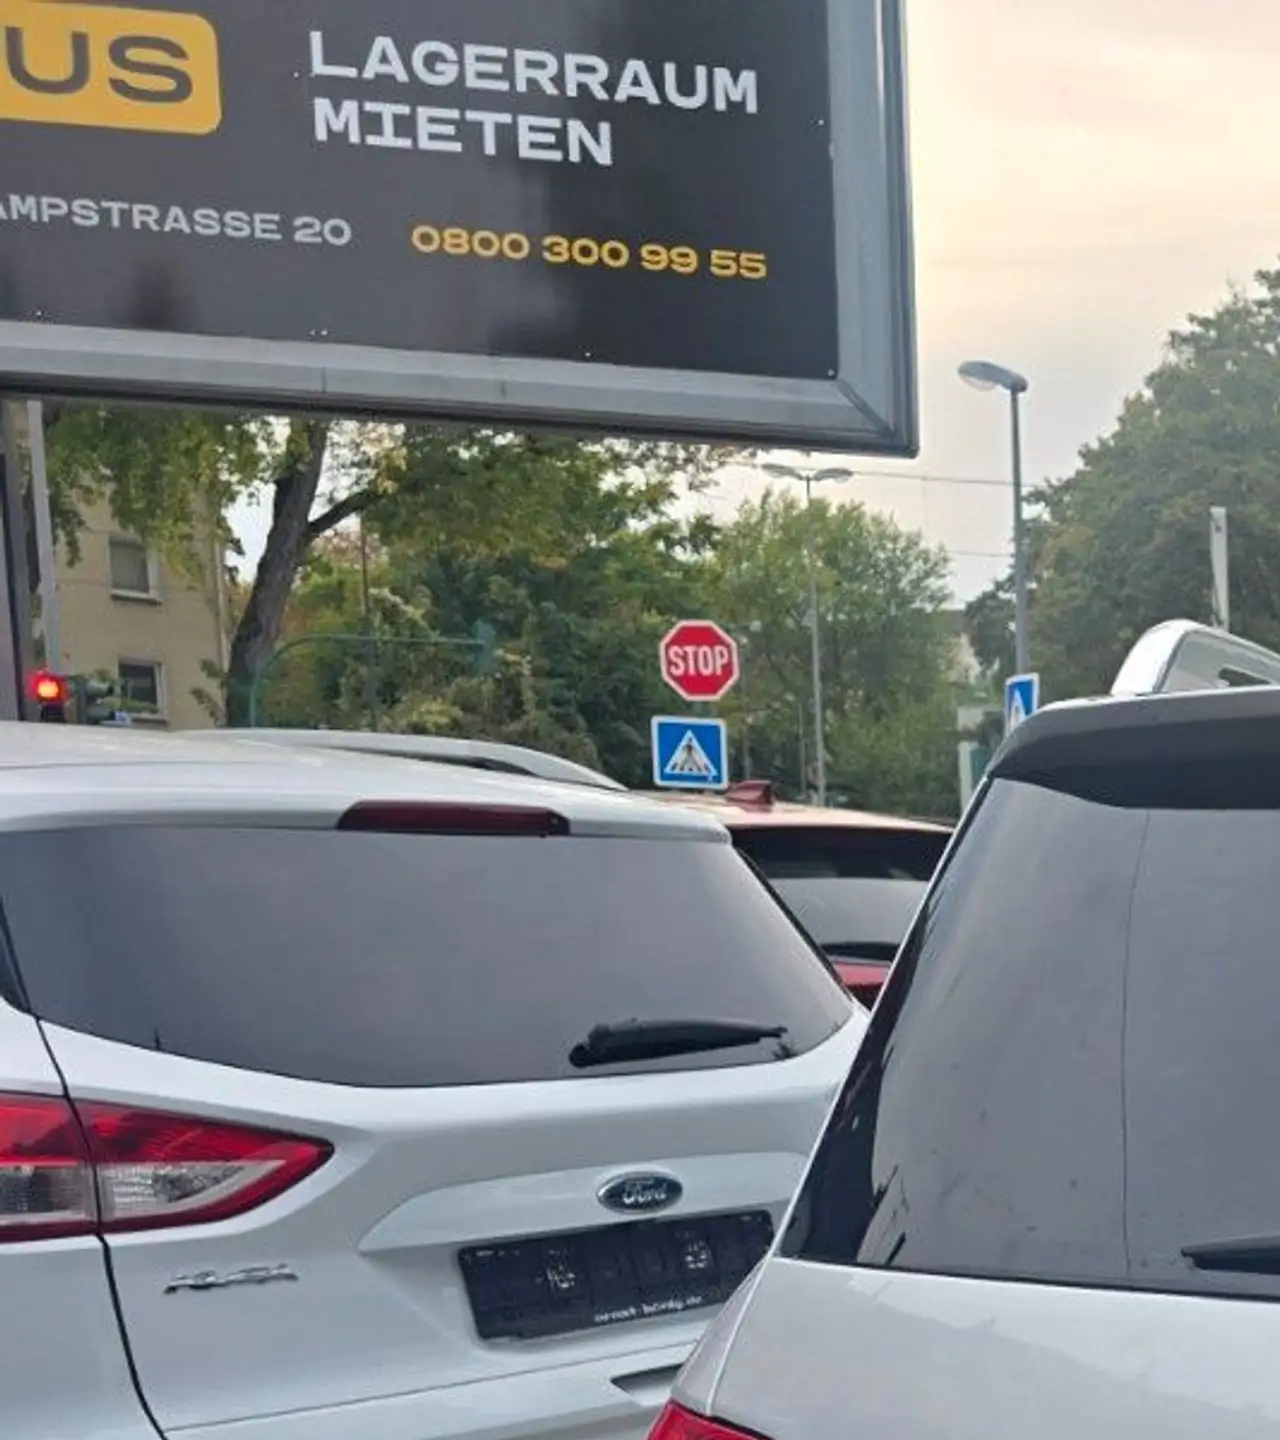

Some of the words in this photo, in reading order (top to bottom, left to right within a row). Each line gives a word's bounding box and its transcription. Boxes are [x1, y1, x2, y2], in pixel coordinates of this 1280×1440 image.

[5, 25, 193, 103] US
[309, 30, 758, 115] LAGERRAUM
[313, 97, 613, 167] MIETEN
[0, 194, 282, 240] MPSTRASSE
[293, 215, 351, 246] 20
[411, 224, 530, 260] 0800
[541, 234, 629, 269] 300
[640, 243, 698, 275] 99
[709, 248, 768, 280] 55
[668, 645, 729, 677] STOP
